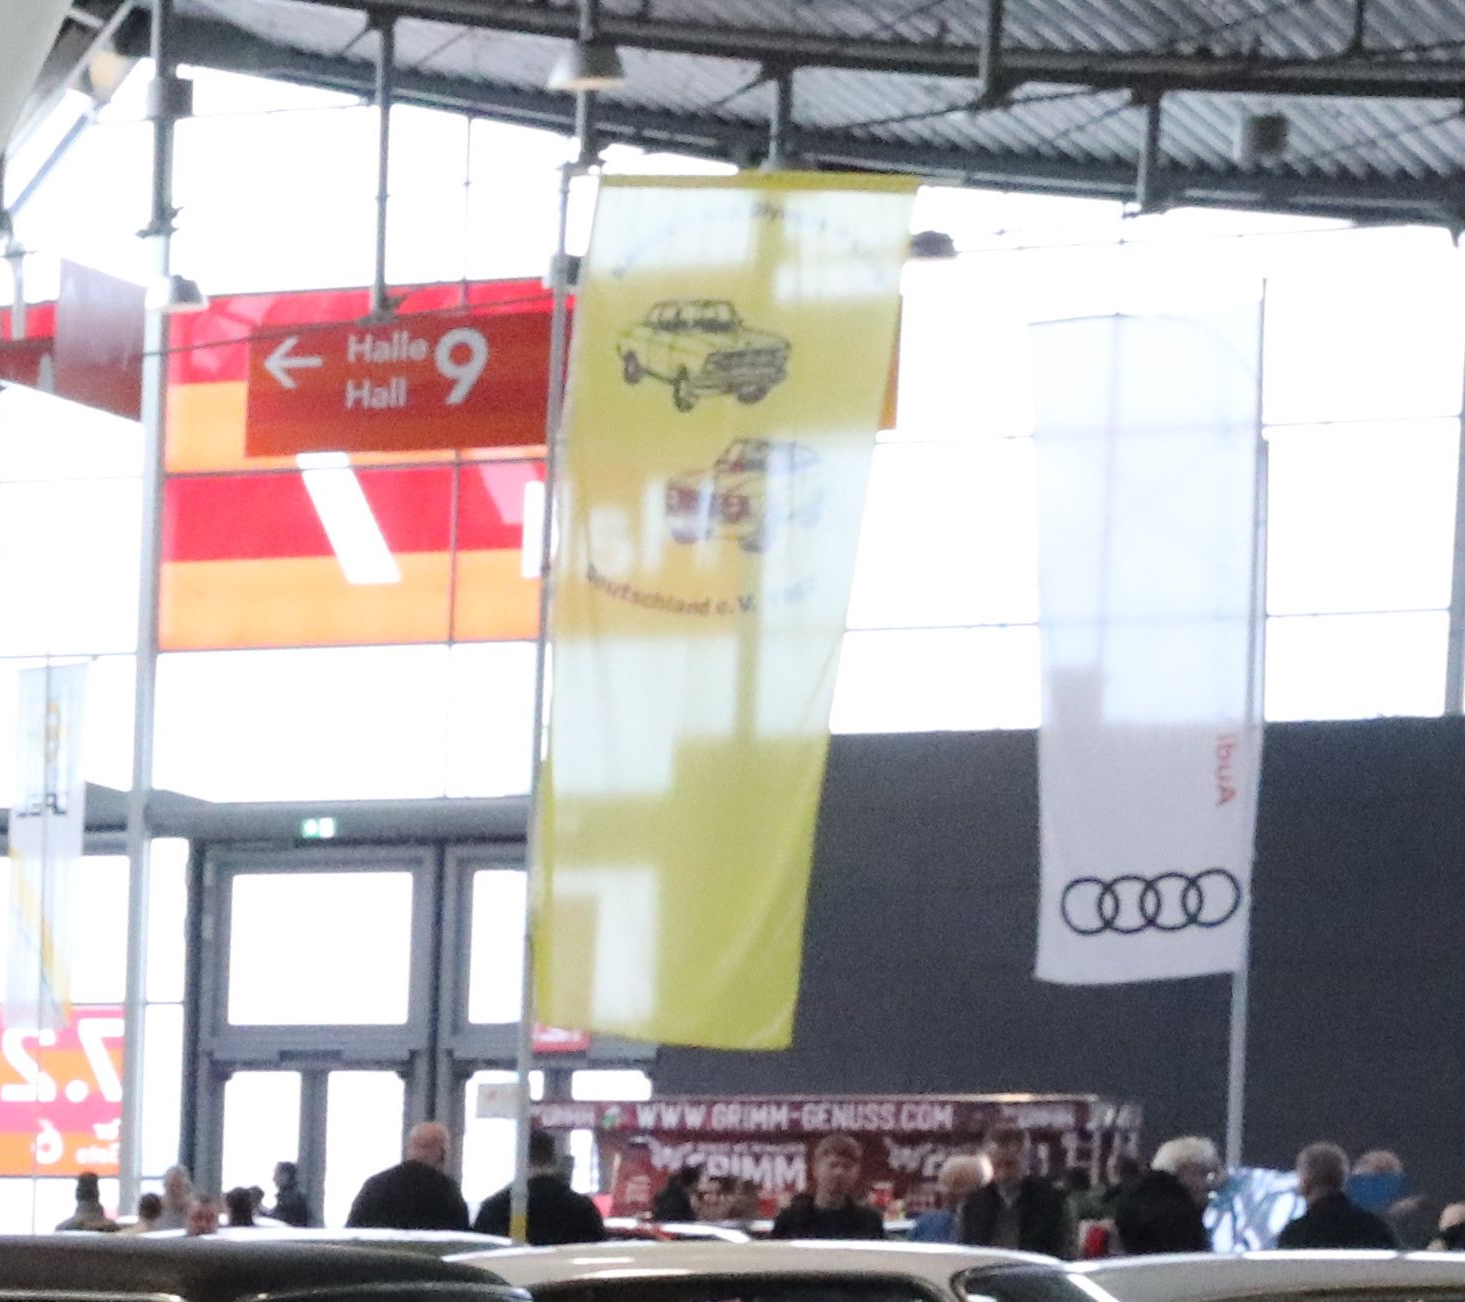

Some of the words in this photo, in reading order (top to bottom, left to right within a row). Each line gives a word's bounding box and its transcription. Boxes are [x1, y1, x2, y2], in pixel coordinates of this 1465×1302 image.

[344, 375, 408, 410] Hall
[346, 330, 430, 364] Halle
[434, 326, 490, 406] 9
